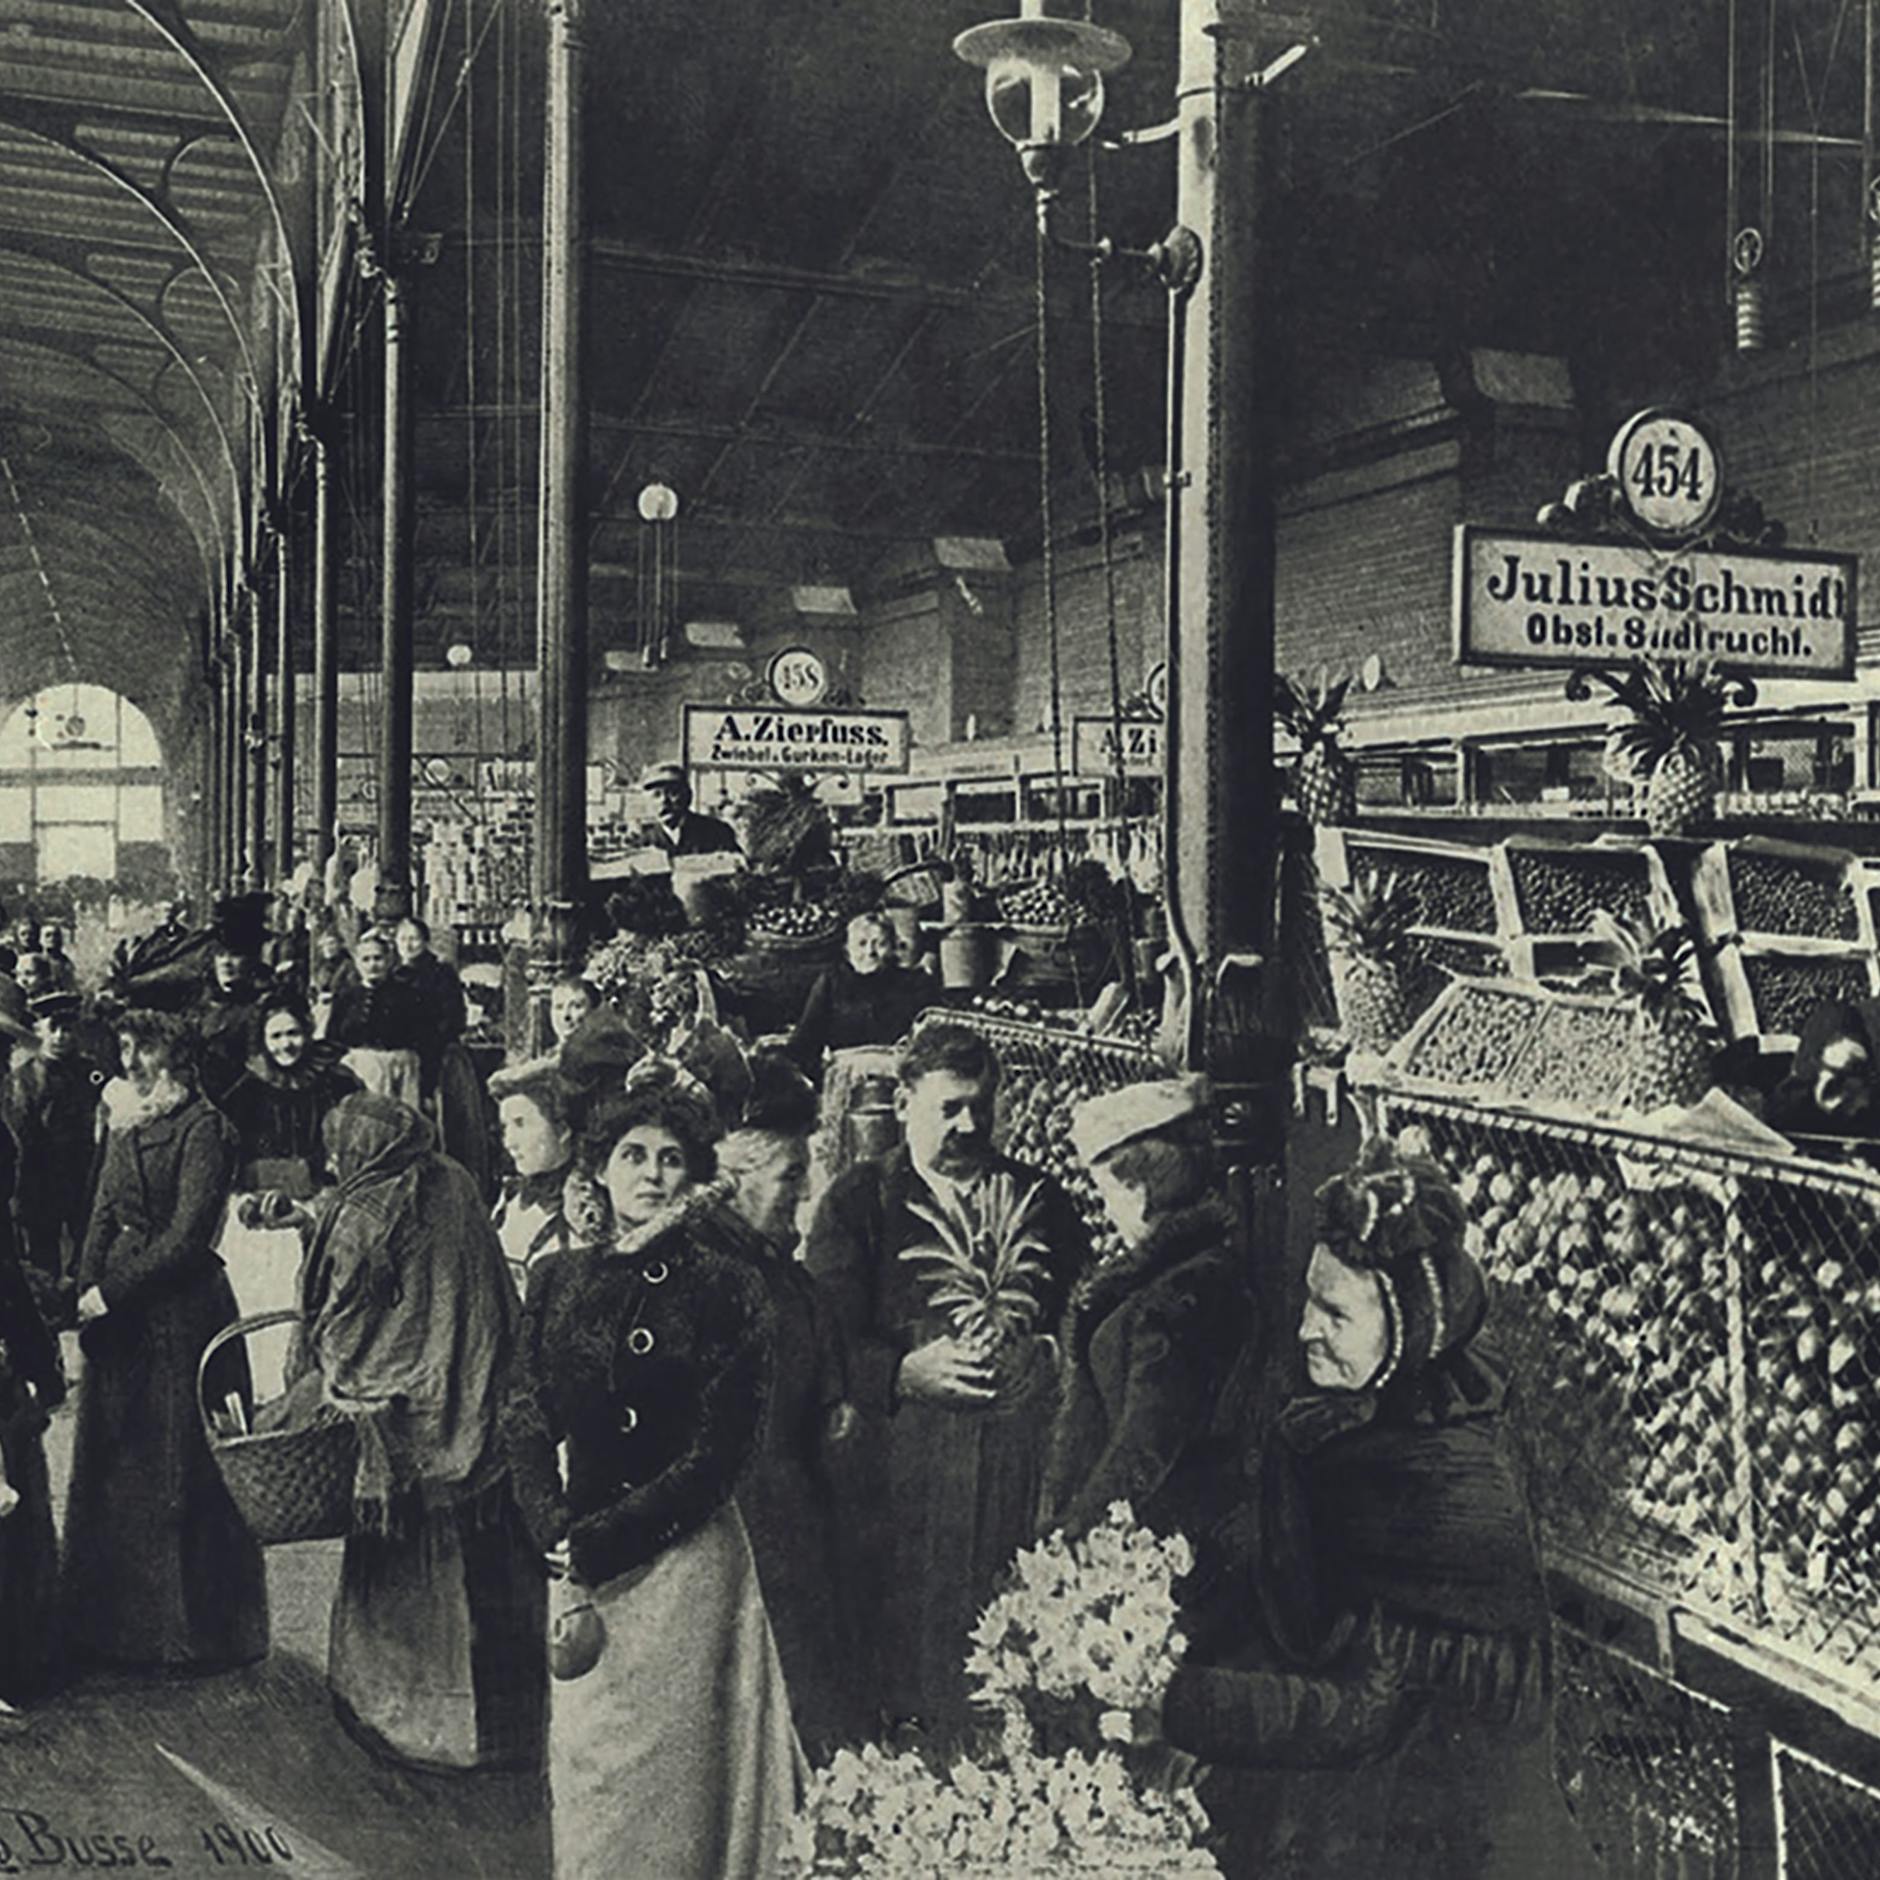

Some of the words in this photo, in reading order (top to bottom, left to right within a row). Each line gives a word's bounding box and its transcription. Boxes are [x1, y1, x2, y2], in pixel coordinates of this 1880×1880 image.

[1632, 444, 1703, 500] 454
[1487, 555, 1658, 612] Julius
[14, 1807, 173, 1868] Busse
[200, 1821, 293, 1866] 1900
